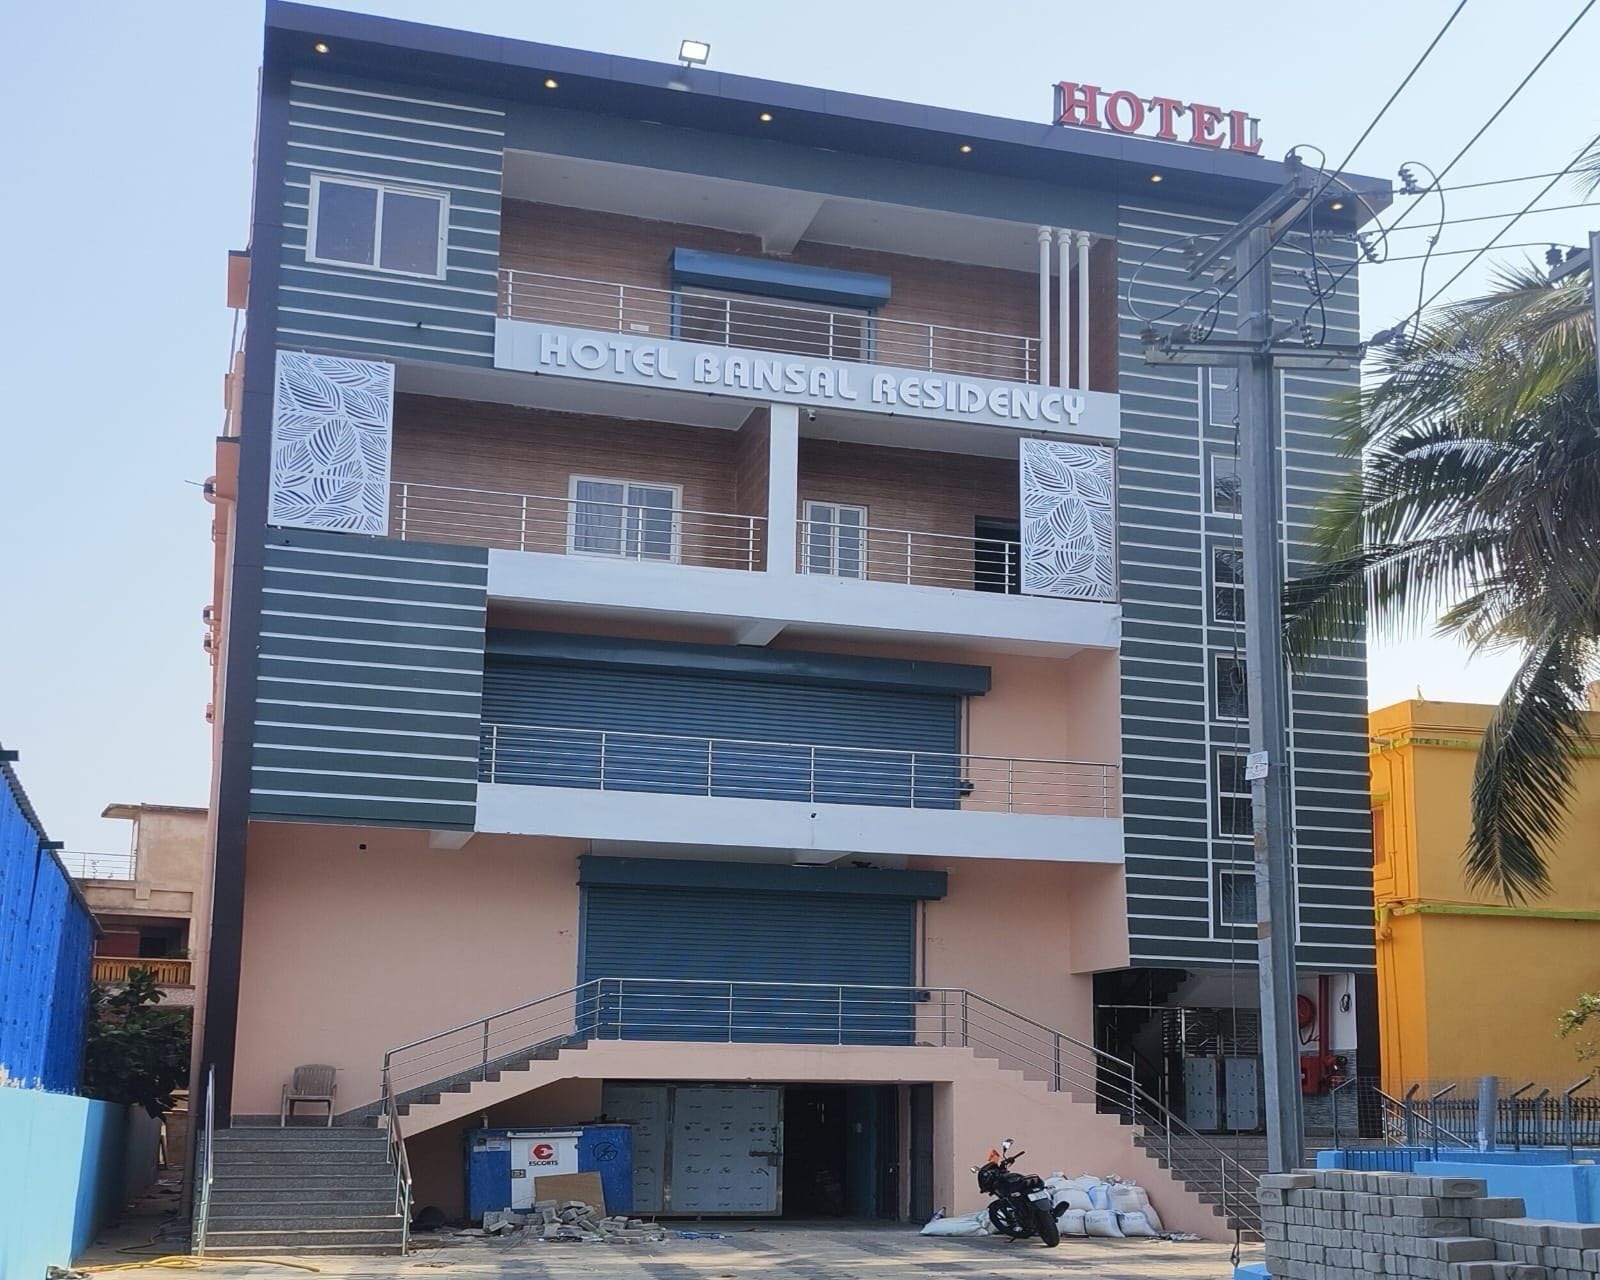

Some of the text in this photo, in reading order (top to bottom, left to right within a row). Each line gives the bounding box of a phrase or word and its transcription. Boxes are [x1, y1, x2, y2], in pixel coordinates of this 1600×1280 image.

[1058, 81, 1263, 155] HOTEL
[540, 332, 1086, 426] HOTEL BANSAL RESIDENCY
